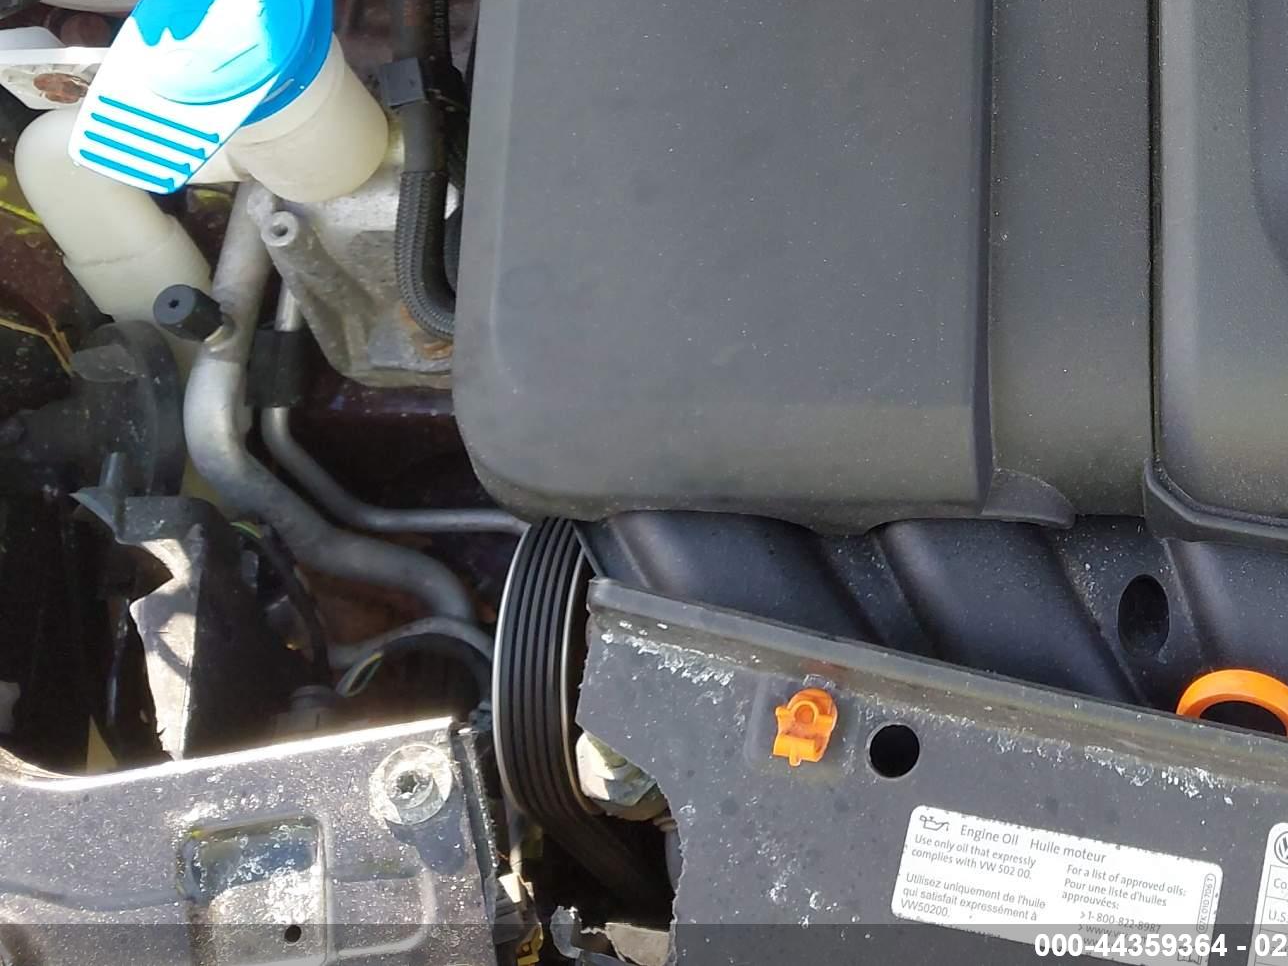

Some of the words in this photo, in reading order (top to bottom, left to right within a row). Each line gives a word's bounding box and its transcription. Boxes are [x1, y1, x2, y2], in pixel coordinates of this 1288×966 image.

[960, 824, 996, 842] Engine
[1002, 833, 1019, 846] Oil
[1029, 838, 1061, 855] Huile
[1063, 847, 1107, 864] moteur
[911, 848, 953, 864] complies
[955, 857, 977, 868] with
[979, 860, 997, 872] VW
[997, 863, 1016, 876] 502
[1016, 867, 1032, 880] 00.
[914, 833, 933, 846] Use
[933, 839, 956, 853] only
[955, 843, 969, 853] oil
[970, 845, 990, 858] that
[991, 851, 1037, 870] expressly
[906, 872, 942, 889] Utilisez
[943, 881, 1001, 901] uniquement
[1002, 892, 1016, 904] de
[1017, 895, 1046, 909] l'huile
[1064, 877, 1085, 891] Pour
[1088, 884, 1107, 895] une
[1108, 885, 1129, 899] liste
[1129, 891, 1167, 907] d'huiles
[1066, 863, 1082, 875] For
[1083, 869, 1090, 878] a
[1091, 868, 1107, 881] list
[1108, 873, 1121, 883] of
[1120, 876, 1166, 892] approved
[1166, 884, 1186, 897] oils:
[902, 887, 919, 898] qui
[920, 890, 958, 906] satisfait
[959, 898, 1029, 920] expressément
[1030, 911, 1037, 921] à
[1061, 891, 1120, 910] approuvées:
